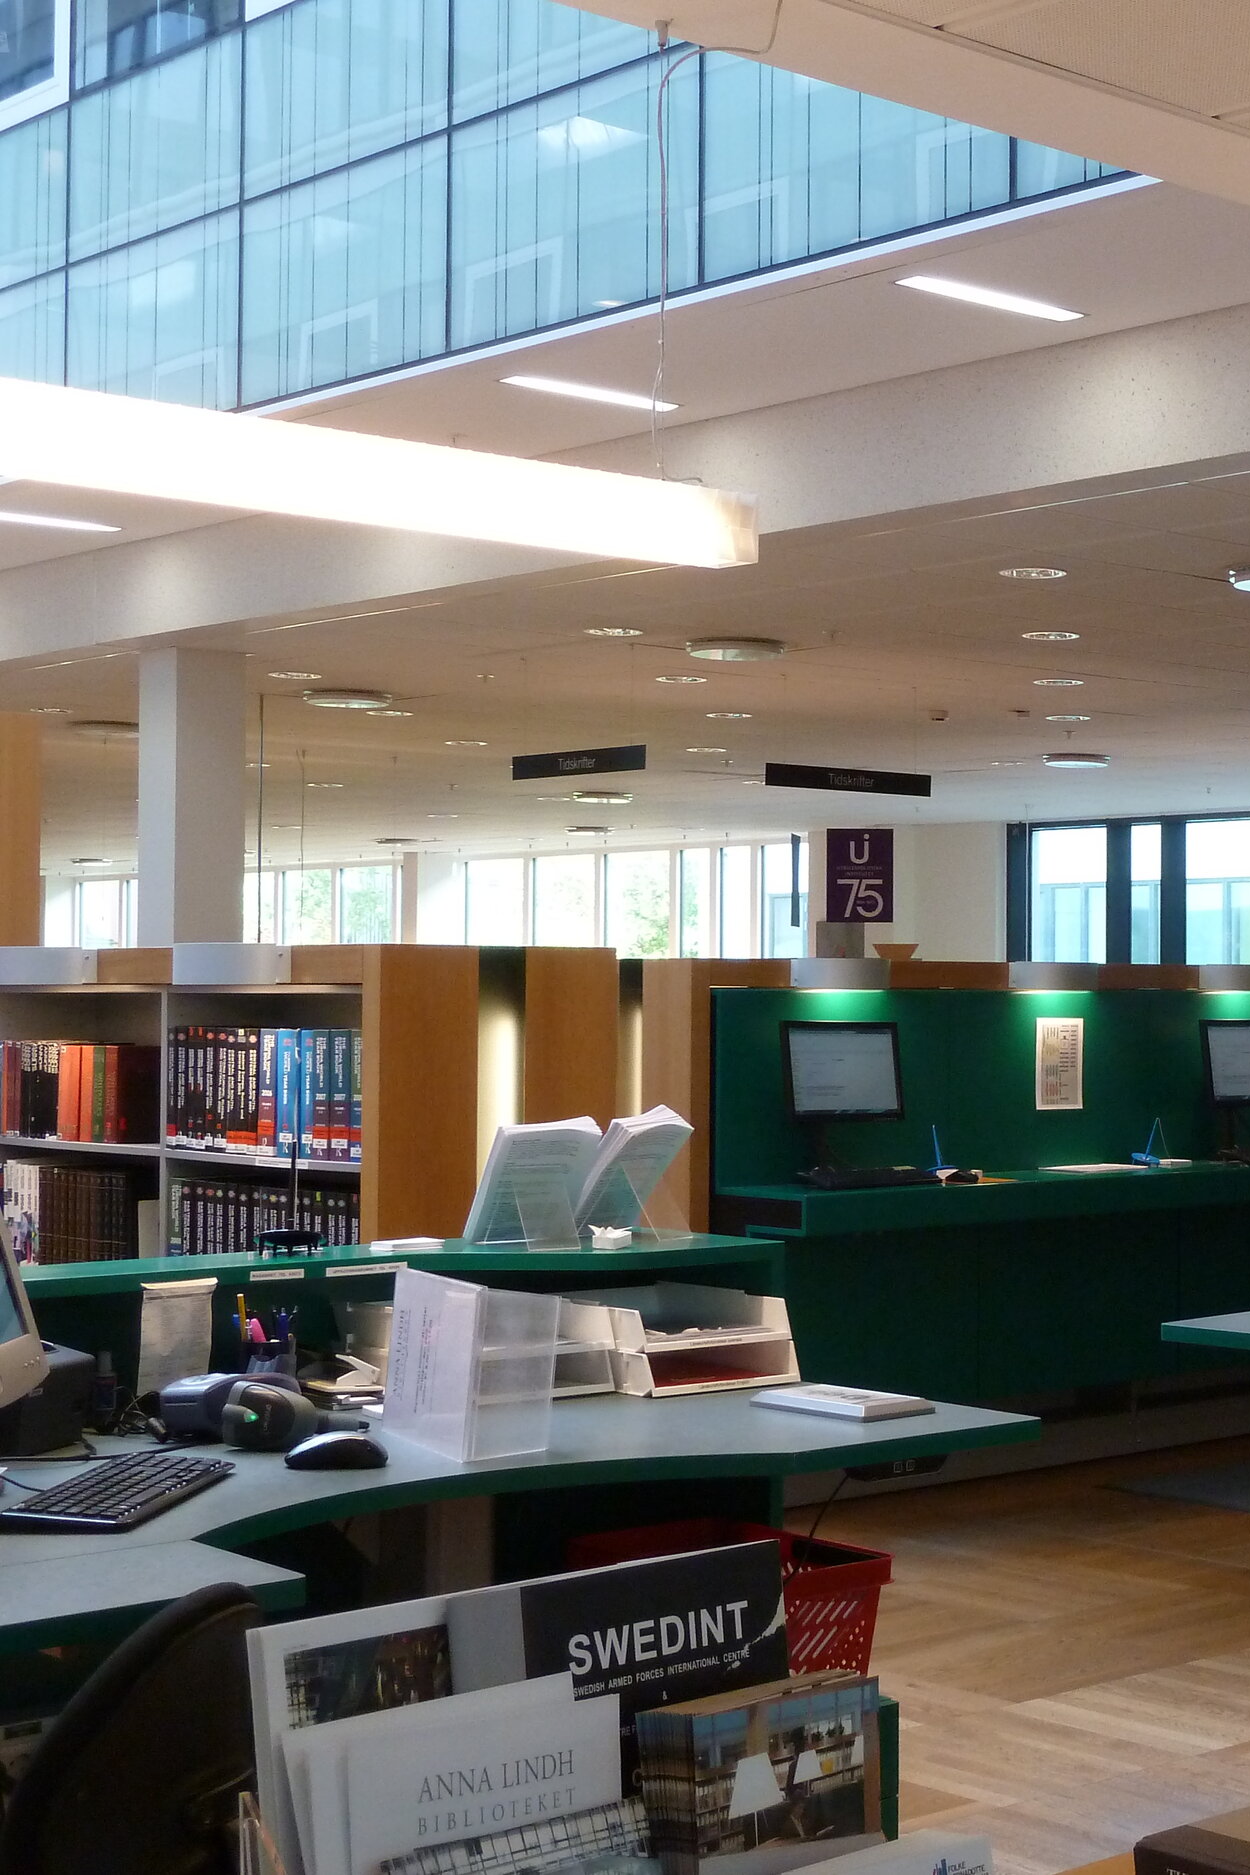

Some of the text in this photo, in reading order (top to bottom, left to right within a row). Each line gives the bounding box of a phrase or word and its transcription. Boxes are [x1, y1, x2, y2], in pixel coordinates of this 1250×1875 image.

[558, 757, 596, 770] Tidskrifter
[828, 773, 875, 788] Tidskrifter
[836, 879, 884, 918] 75
[568, 1600, 748, 1676] SWEDINT
[573, 1648, 750, 1697] SWEDISH ARMED FORCES INTERNATIONAL CENTRE
[417, 1749, 575, 1804] ANNA LINDH
[418, 1786, 577, 1836] BIBLIOTEKET
